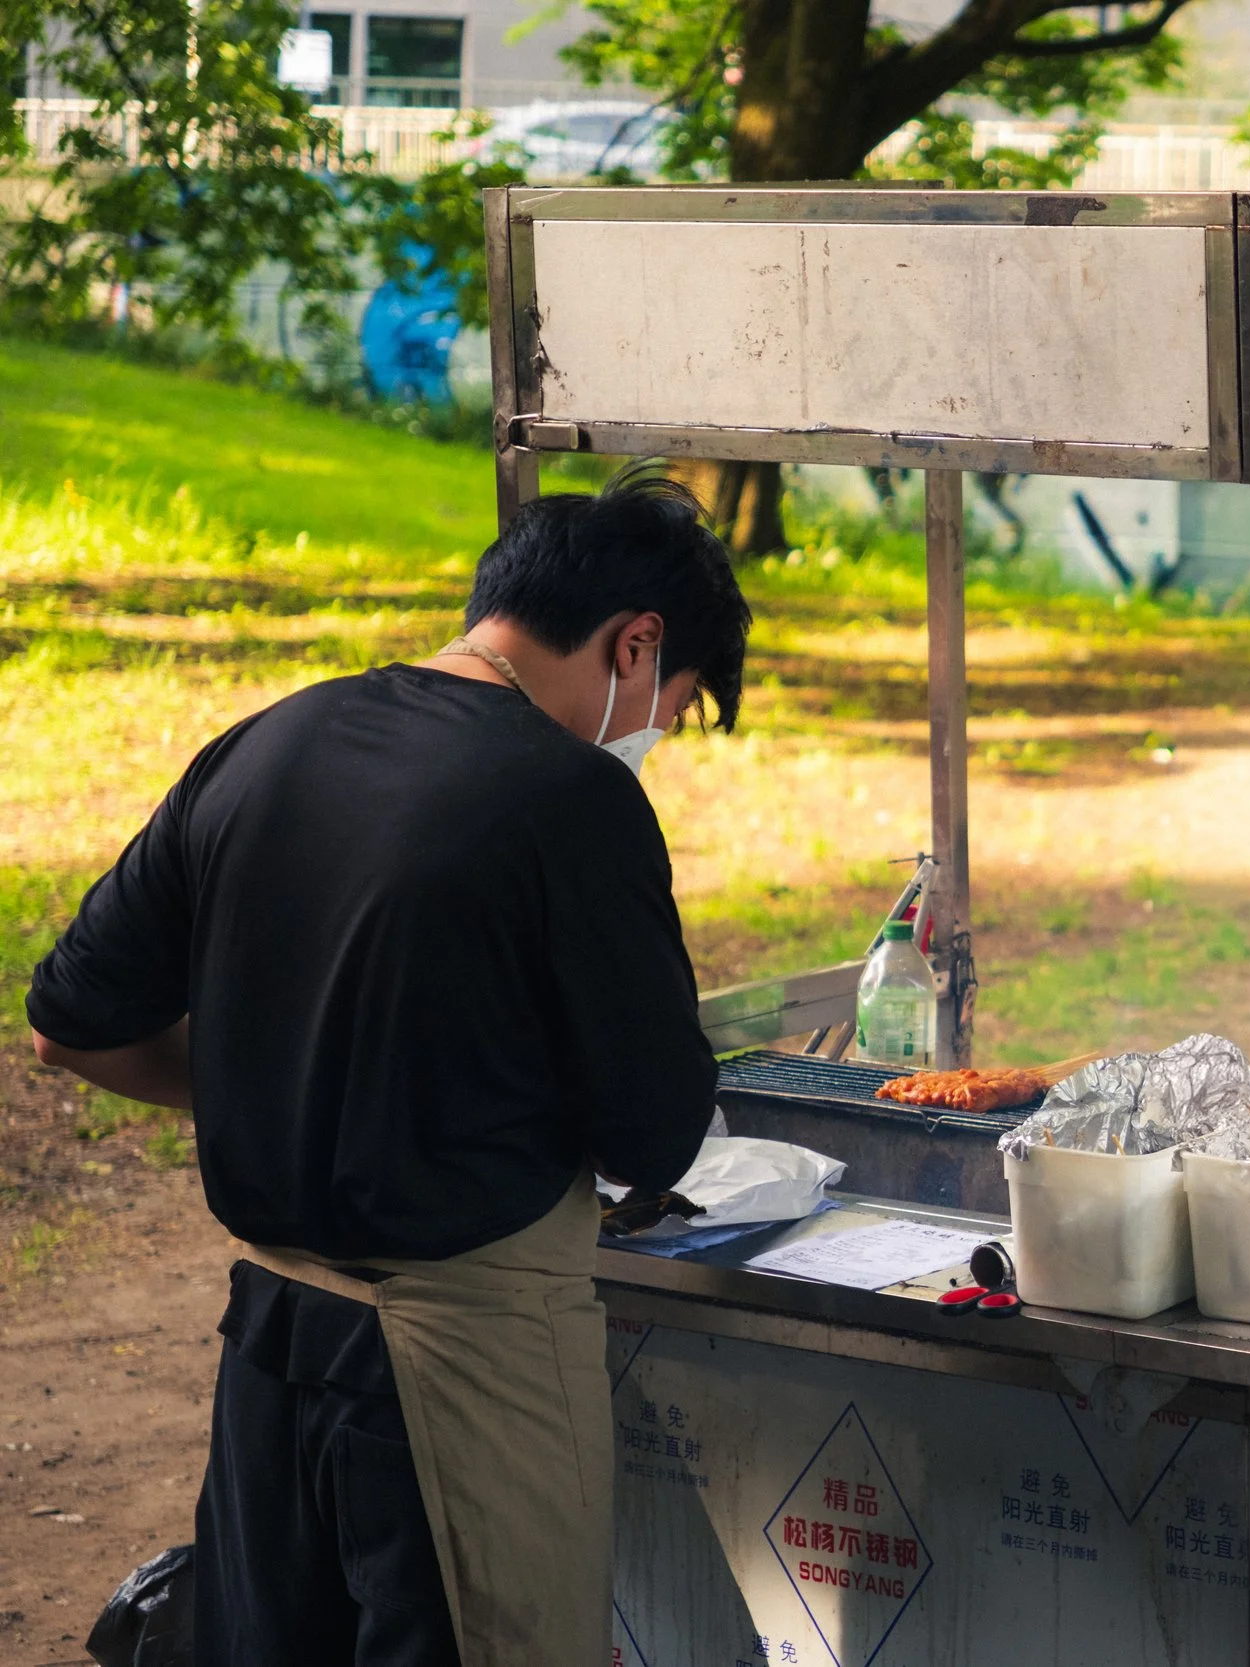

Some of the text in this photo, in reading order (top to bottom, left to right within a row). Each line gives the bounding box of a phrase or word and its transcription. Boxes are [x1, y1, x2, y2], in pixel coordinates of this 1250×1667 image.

[623, 1426, 703, 1462] 阳光直射
[823, 1477, 878, 1516] 精品
[1020, 1467, 1071, 1499] 避免
[1002, 1495, 1091, 1534] 阳光直射
[783, 1515, 918, 1570] 松杨不锈钢
[799, 1561, 905, 1600] SONGYANG
[752, 1634, 799, 1664] 避免
